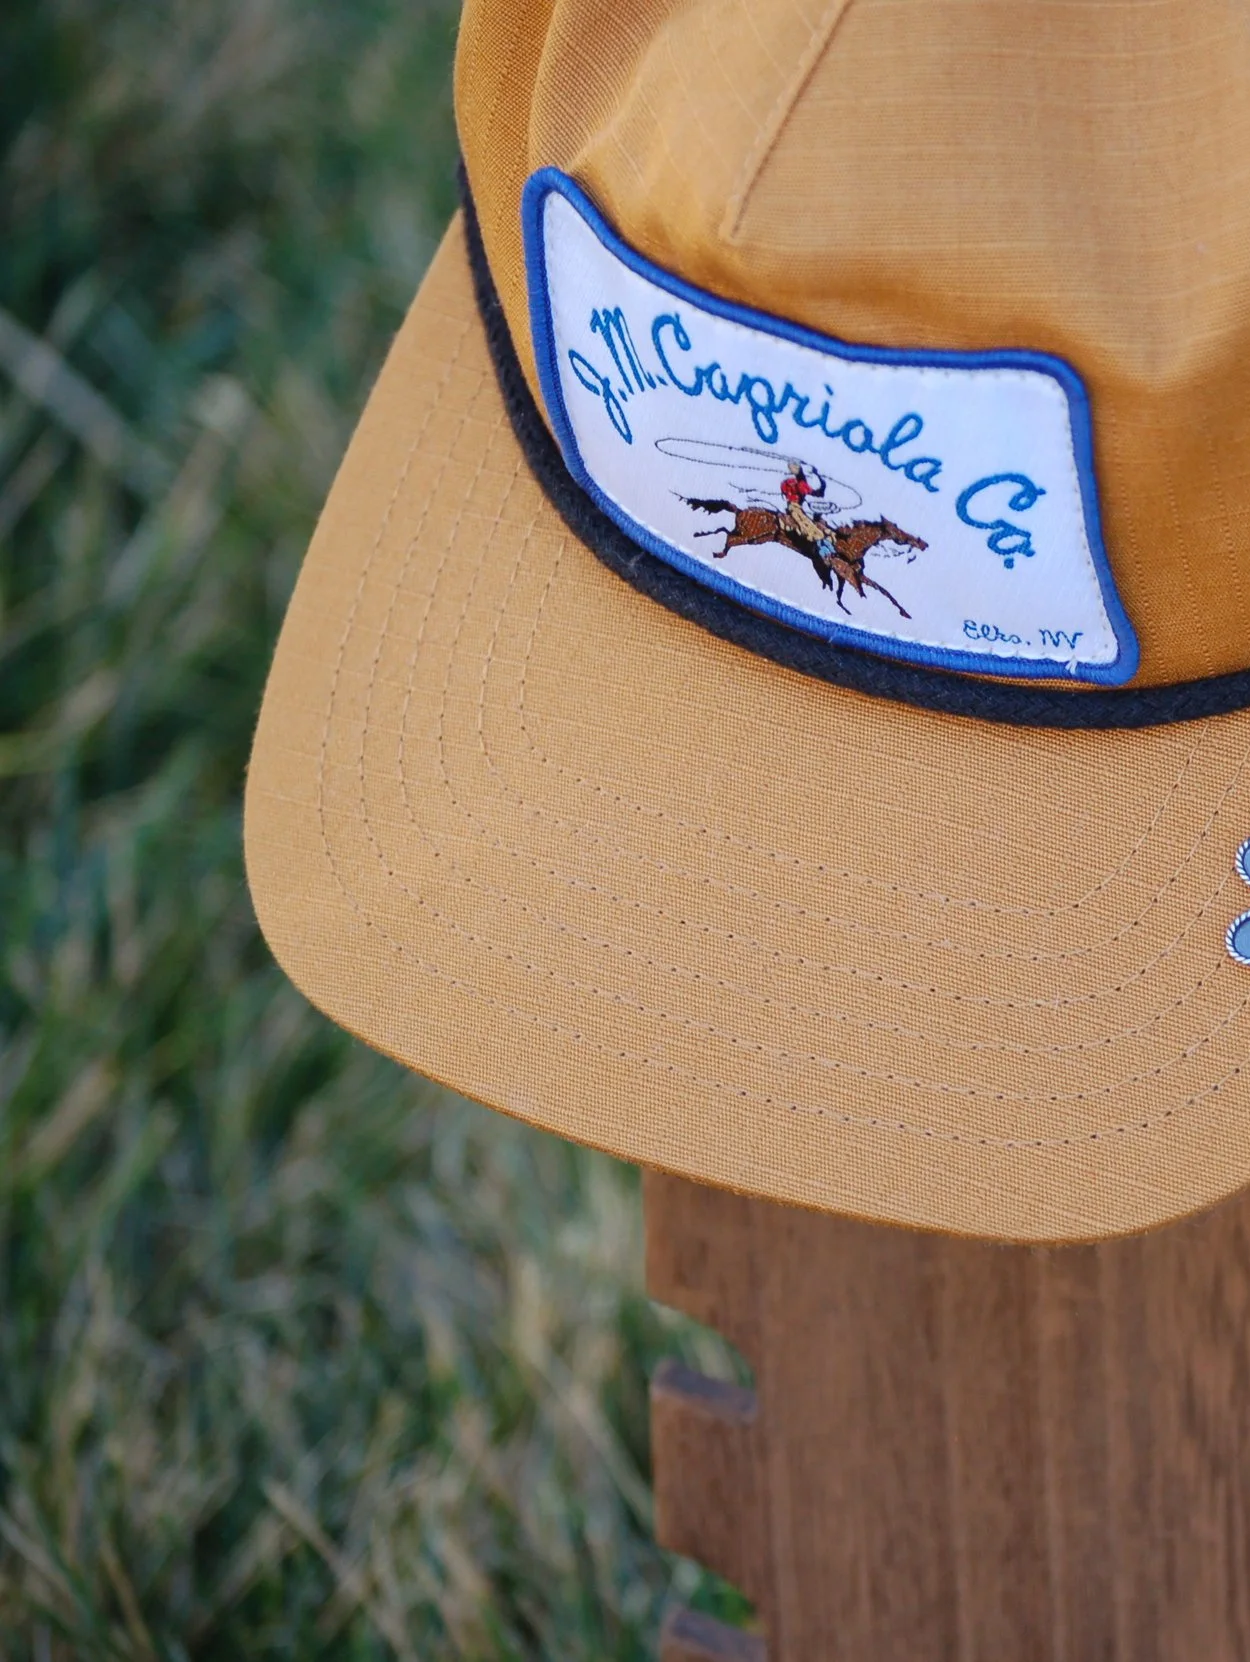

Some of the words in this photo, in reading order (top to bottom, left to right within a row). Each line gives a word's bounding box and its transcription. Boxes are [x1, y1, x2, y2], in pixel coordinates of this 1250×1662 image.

[651, 312, 942, 492] Capriola
[955, 473, 1046, 569] Co.
[1038, 628, 1083, 649] NV
